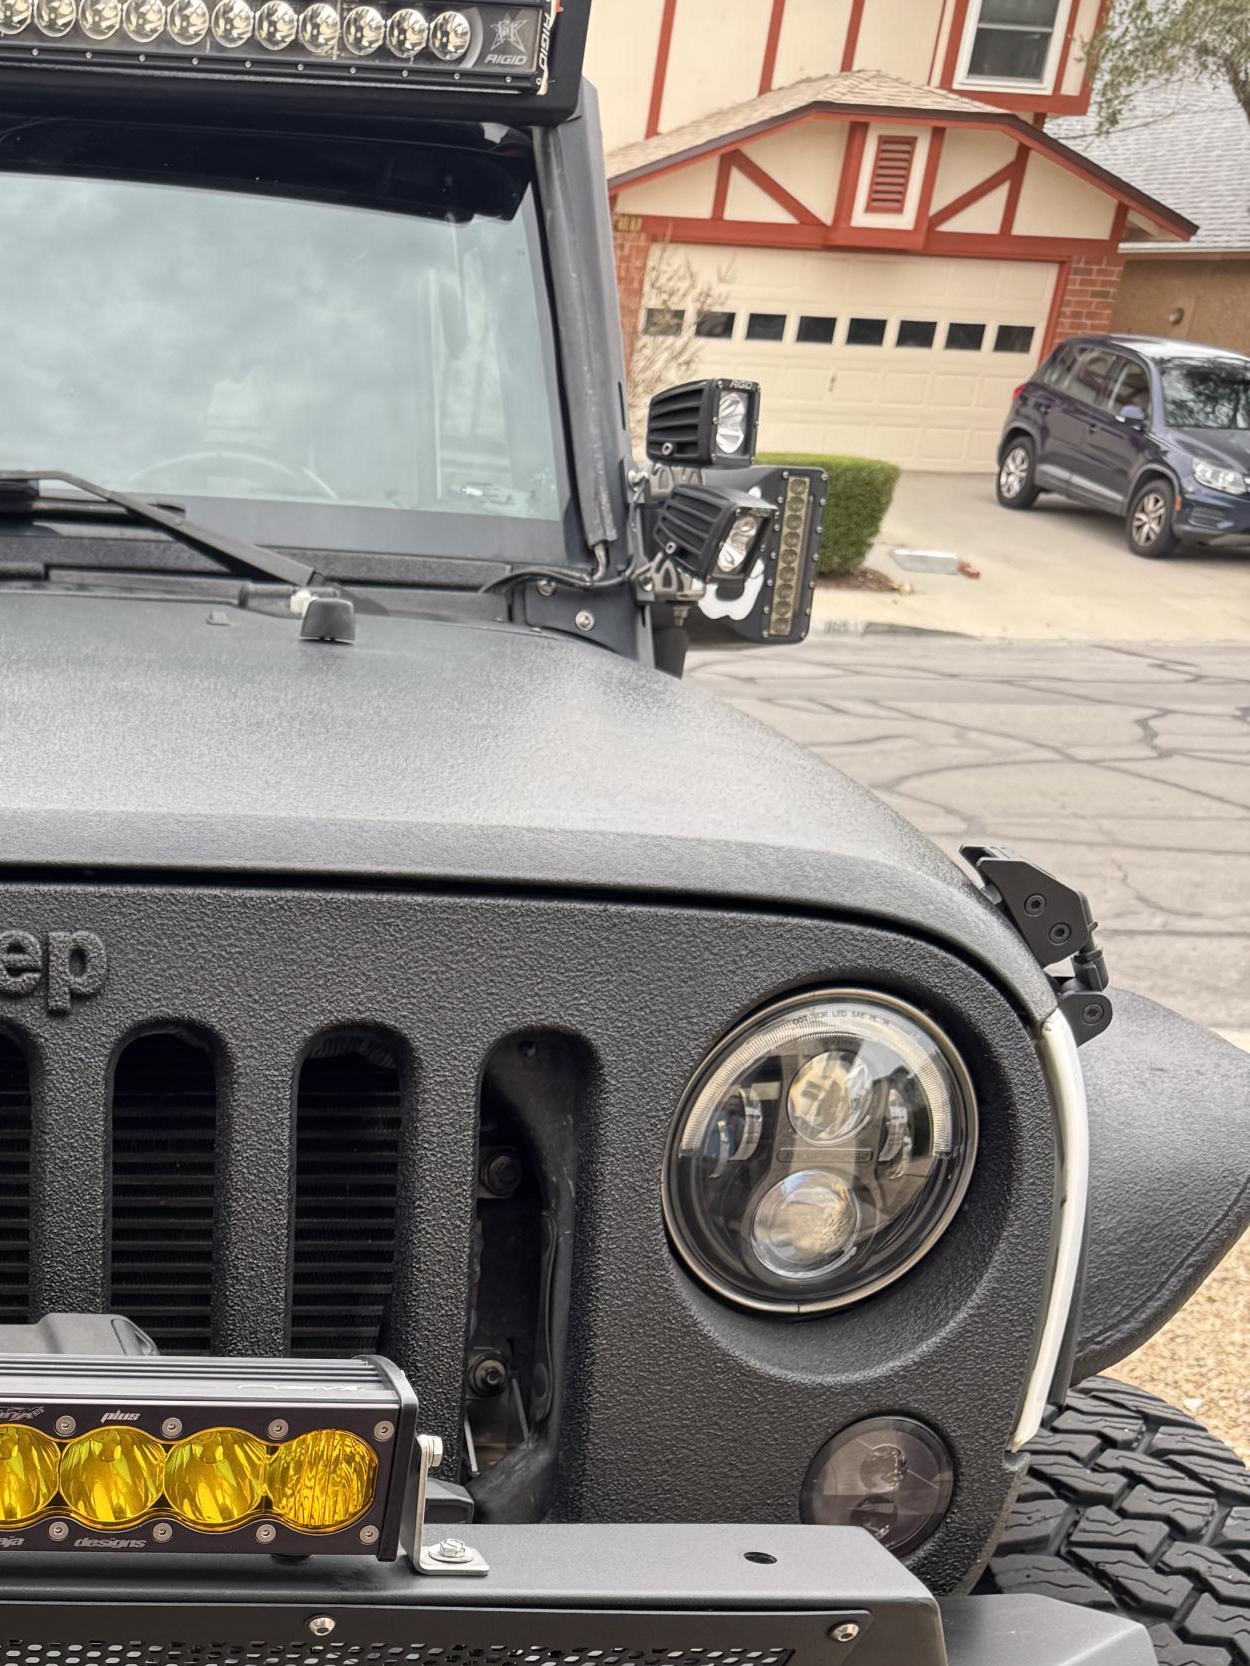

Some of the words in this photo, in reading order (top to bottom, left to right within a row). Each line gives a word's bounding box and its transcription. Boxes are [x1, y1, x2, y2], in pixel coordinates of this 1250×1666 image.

[483, 53, 528, 66] RIGID
[100, 1409, 141, 1424] plus
[73, 1537, 147, 1549] designs
